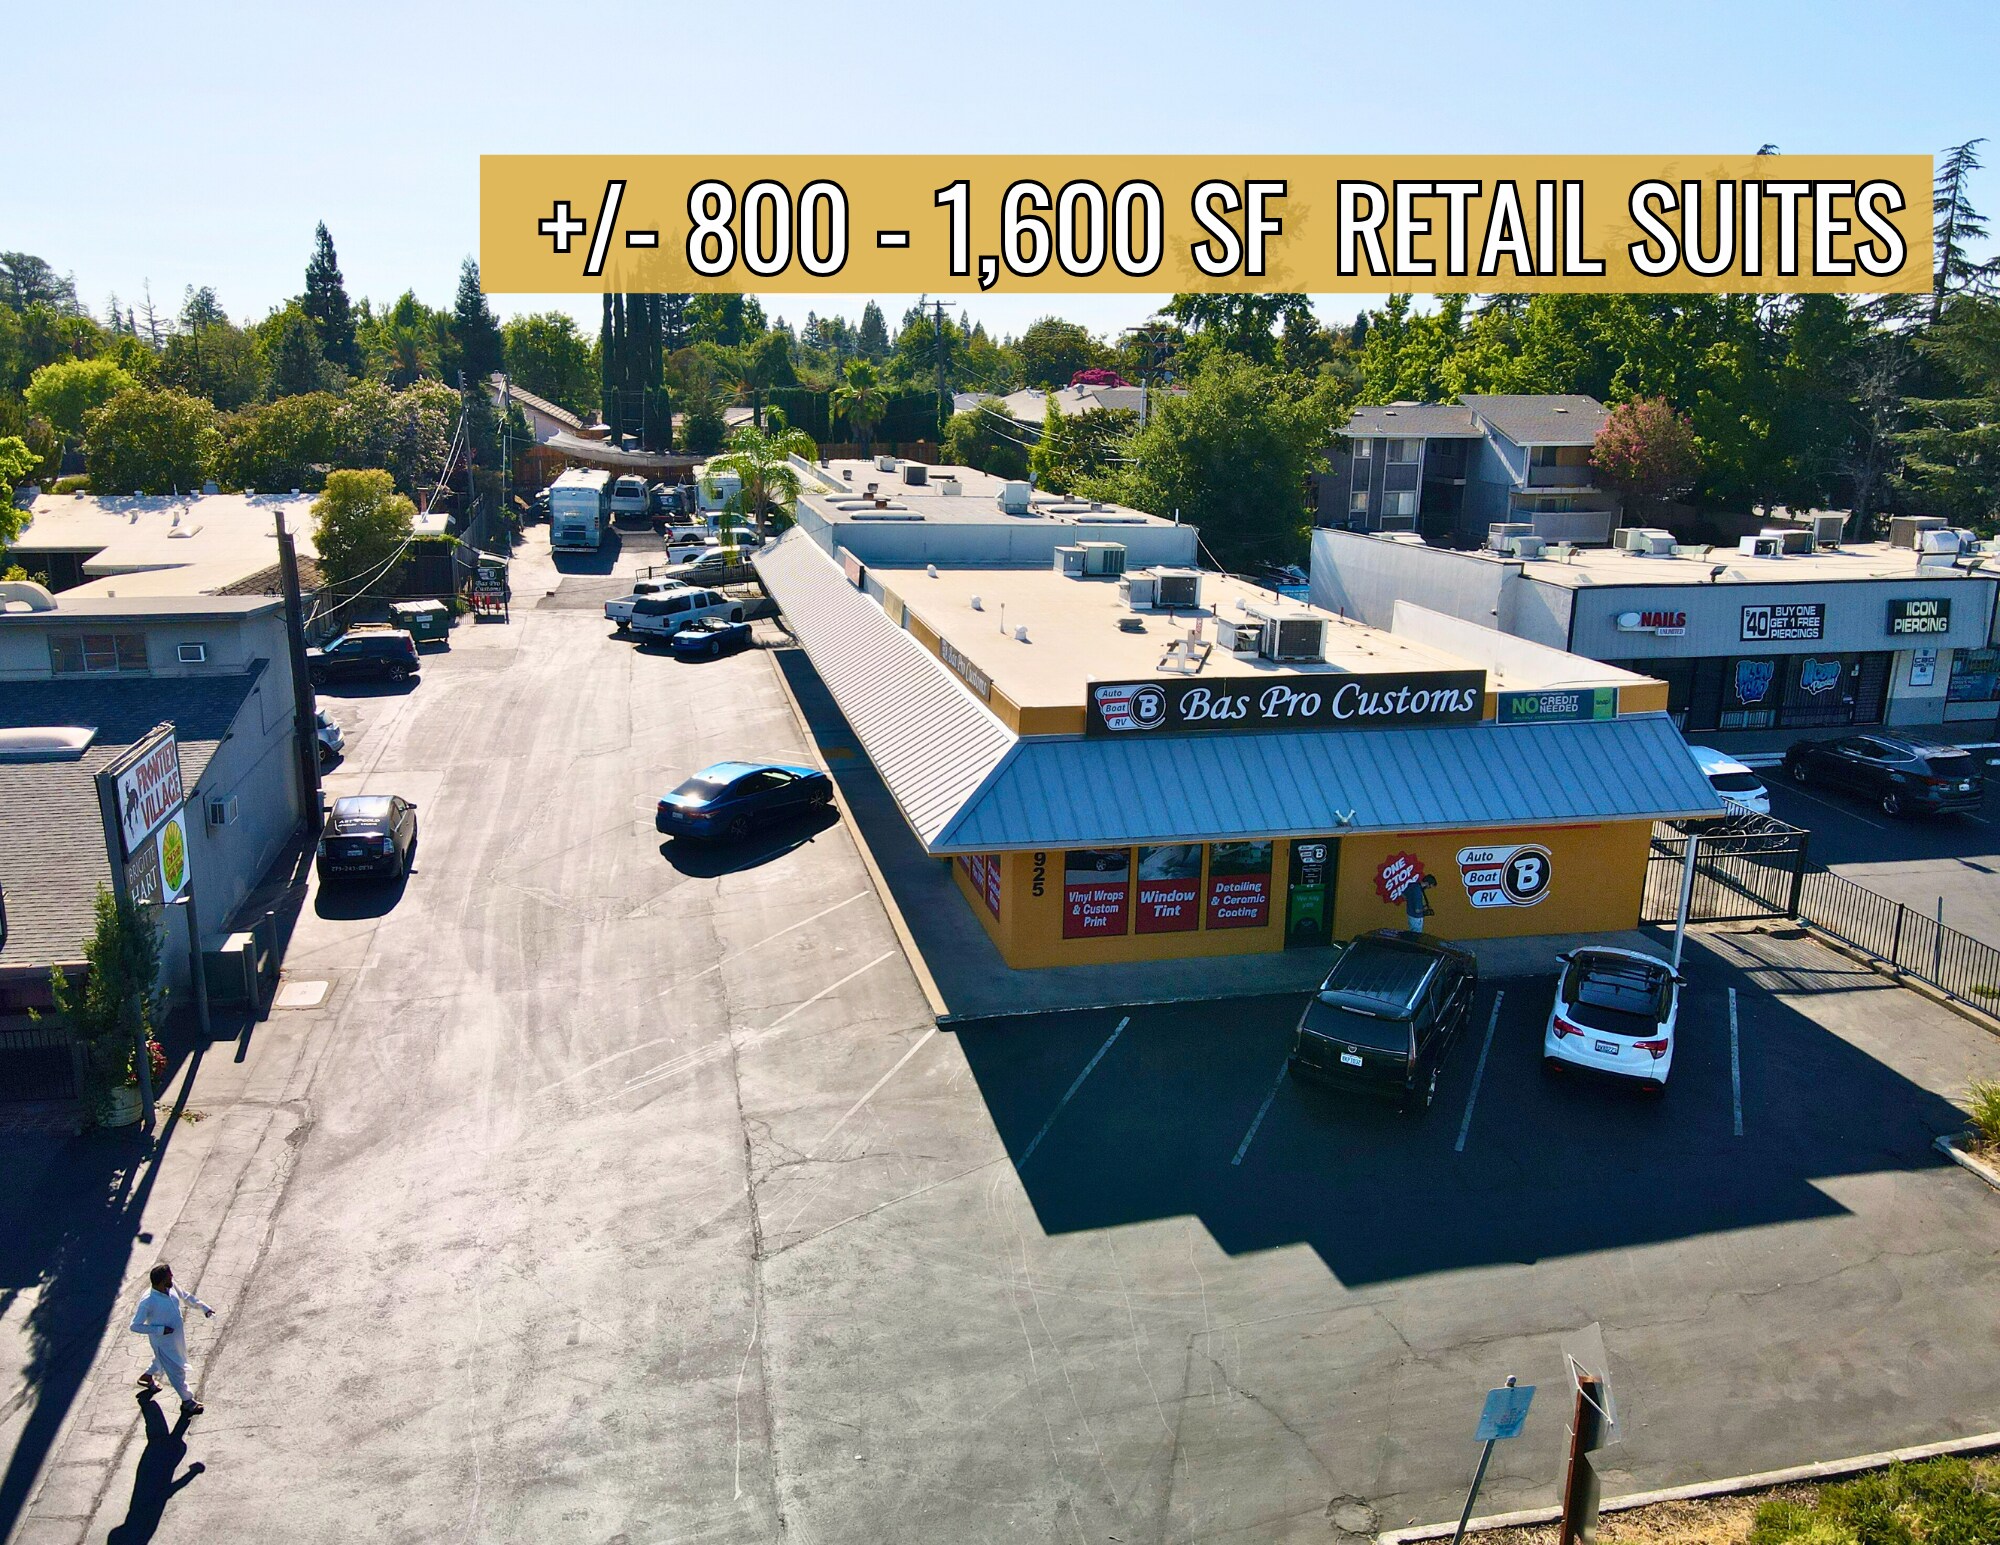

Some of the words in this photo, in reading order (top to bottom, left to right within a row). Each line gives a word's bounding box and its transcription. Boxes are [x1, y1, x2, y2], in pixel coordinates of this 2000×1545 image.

[1775, 606, 1796, 617] BUY
[1796, 605, 1817, 616] ONE
[1906, 601, 1938, 616] IICON
[1641, 611, 1686, 627] NAILS
[1770, 617, 1789, 628] GET
[1790, 617, 1795, 627] 1
[1797, 617, 1820, 627] FREE
[1894, 617, 1947, 633] PIERCING
[1770, 628, 1819, 639] PIERCINGS
[1102, 689, 1123, 698] Auto
[1540, 695, 1579, 705] CREDIT
[1105, 703, 1126, 713] Boat
[1138, 694, 1159, 719] B
[1179, 686, 1250, 721] Bas
[1259, 685, 1321, 719] Pro
[1332, 683, 1477, 720] Customs
[1512, 697, 1539, 714] NO
[1540, 704, 1579, 714] NEEDED
[1114, 718, 1128, 727] RV
[136, 740, 177, 798] FRONTIER
[141, 771, 181, 830] VILLAGE
[1466, 851, 1494, 862] Auto
[128, 844, 155, 885] BRIGITTE
[1382, 856, 1406, 879] ONE
[1032, 852, 1046, 897] 925
[1385, 864, 1414, 891] STOP
[1469, 872, 1498, 883] Boat
[1514, 857, 1542, 892] B
[131, 865, 157, 911] HART
[1215, 881, 1262, 893] Detailing
[1069, 891, 1091, 904] Vinyl
[1094, 890, 1124, 902] Wraps
[1140, 889, 1195, 904] Window
[1210, 896, 1220, 906] &
[1223, 893, 1266, 905] Ceramic
[1480, 891, 1498, 903] RV
[1072, 904, 1081, 915] &
[1083, 903, 1119, 915] Custom
[1153, 904, 1181, 917] Tint
[1217, 907, 1258, 918] Coating
[1083, 916, 1107, 927] Print
